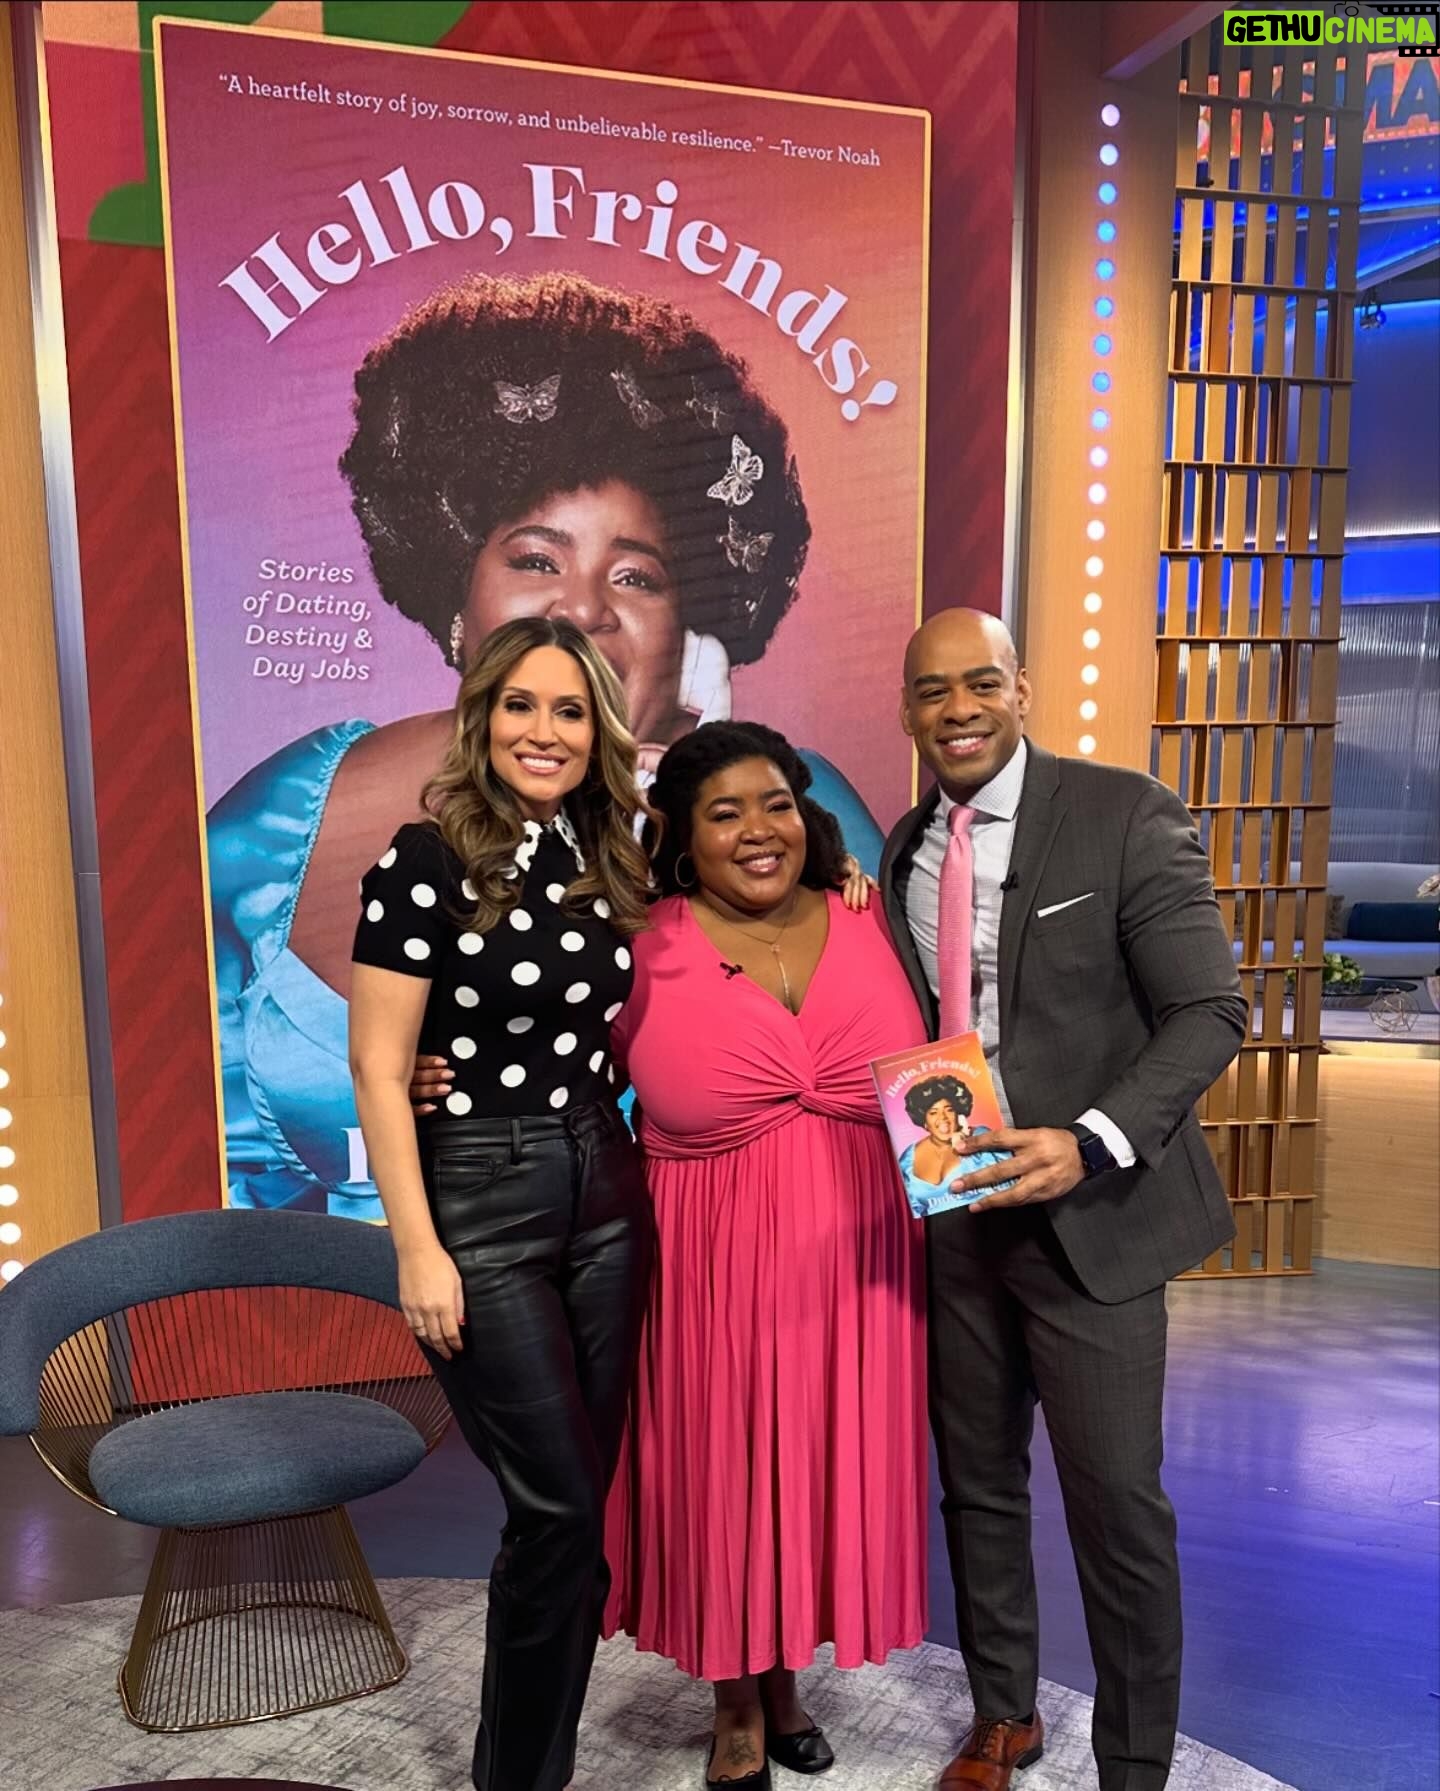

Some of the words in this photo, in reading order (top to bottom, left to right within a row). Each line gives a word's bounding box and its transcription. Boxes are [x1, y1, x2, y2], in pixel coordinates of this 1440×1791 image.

[249, 76, 331, 104] heartfelt
[336, 92, 383, 113] story
[388, 94, 407, 112] of
[410, 97, 443, 118] joy,
[447, 105, 513, 125] sorrow,
[517, 112, 550, 129] and
[555, 112, 667, 142] unbelievable
[838, 146, 880, 166] Noah
[218, 165, 513, 344] Hello,
[522, 163, 898, 421] Friends!
[258, 559, 354, 583] Stories
[243, 590, 273, 618] of
[276, 593, 371, 622] Dating,
[245, 624, 347, 653] Destiny
[353, 628, 373, 648] &
[253, 656, 304, 684] Day
[311, 658, 369, 680] Jobs
